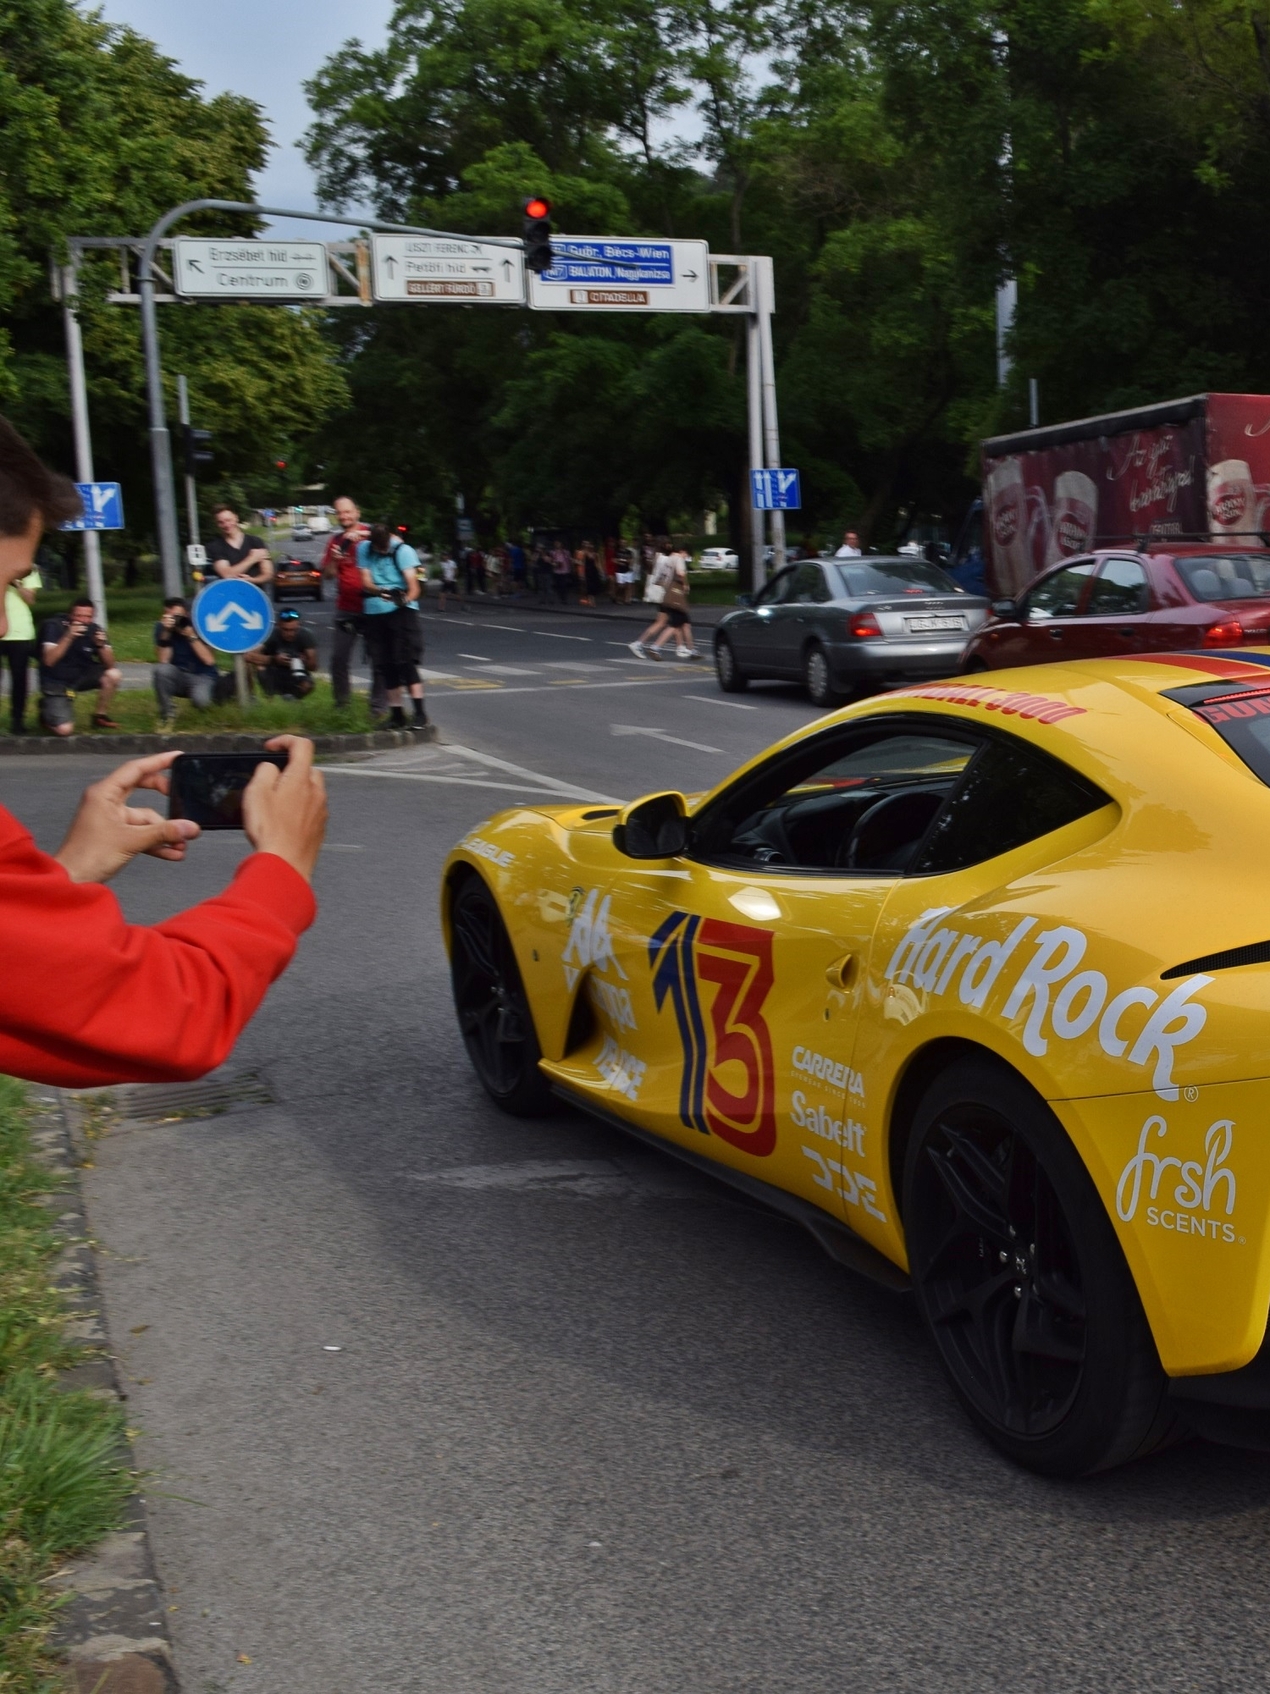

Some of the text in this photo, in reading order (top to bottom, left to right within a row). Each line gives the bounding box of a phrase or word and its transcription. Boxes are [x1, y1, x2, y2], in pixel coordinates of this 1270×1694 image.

[216, 273, 289, 287] Centrum
[589, 291, 646, 303] CITADELLA
[647, 910, 777, 1158] 13
[884, 905, 1216, 1102] Hard Rock
[791, 1045, 866, 1098] CARRERA
[790, 1089, 866, 1158] Sabelt
[1115, 1114, 1237, 1222] frsh
[1146, 1206, 1236, 1243] SCENTS
